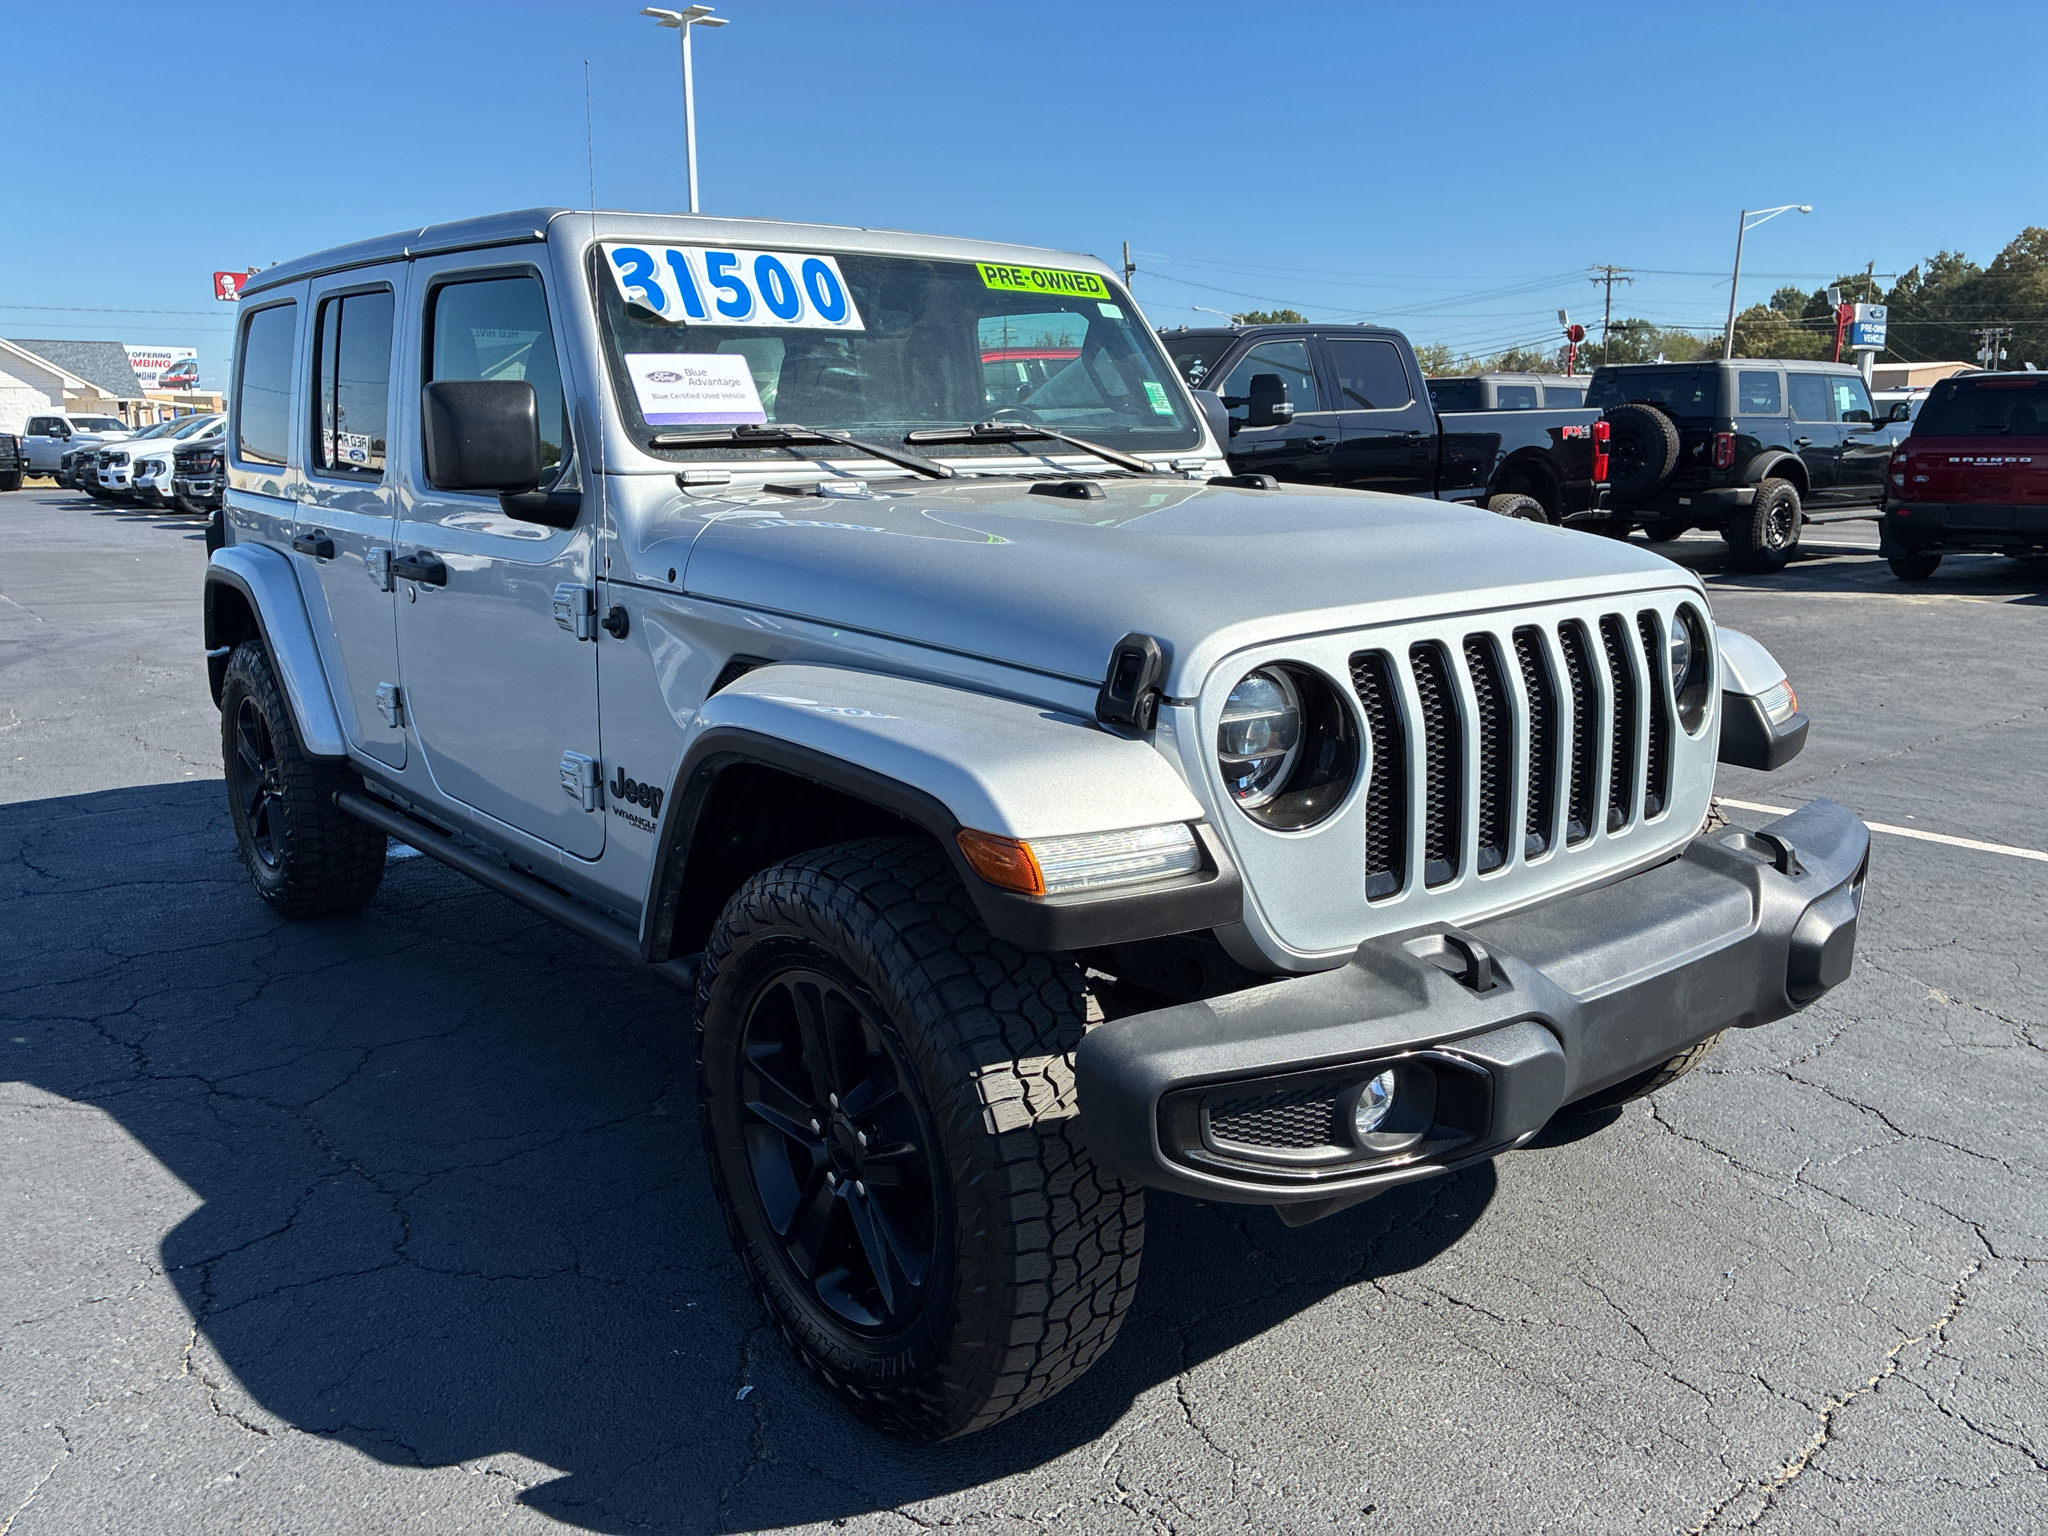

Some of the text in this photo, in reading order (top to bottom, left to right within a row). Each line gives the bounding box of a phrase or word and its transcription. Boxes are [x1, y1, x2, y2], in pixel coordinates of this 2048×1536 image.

[611, 247, 848, 323] 31500
[983, 265, 1101, 294] PRE-OWNED
[132, 351, 172, 359] OFFERING
[684, 368, 708, 377] Blue
[688, 378, 742, 388] Advantage
[670, 392, 701, 400] Certified
[1562, 425, 1591, 440] FX4
[610, 767, 664, 819] Jeep
[612, 805, 658, 831] WRANGLE
[628, 820, 657, 835] UNLIMIT
